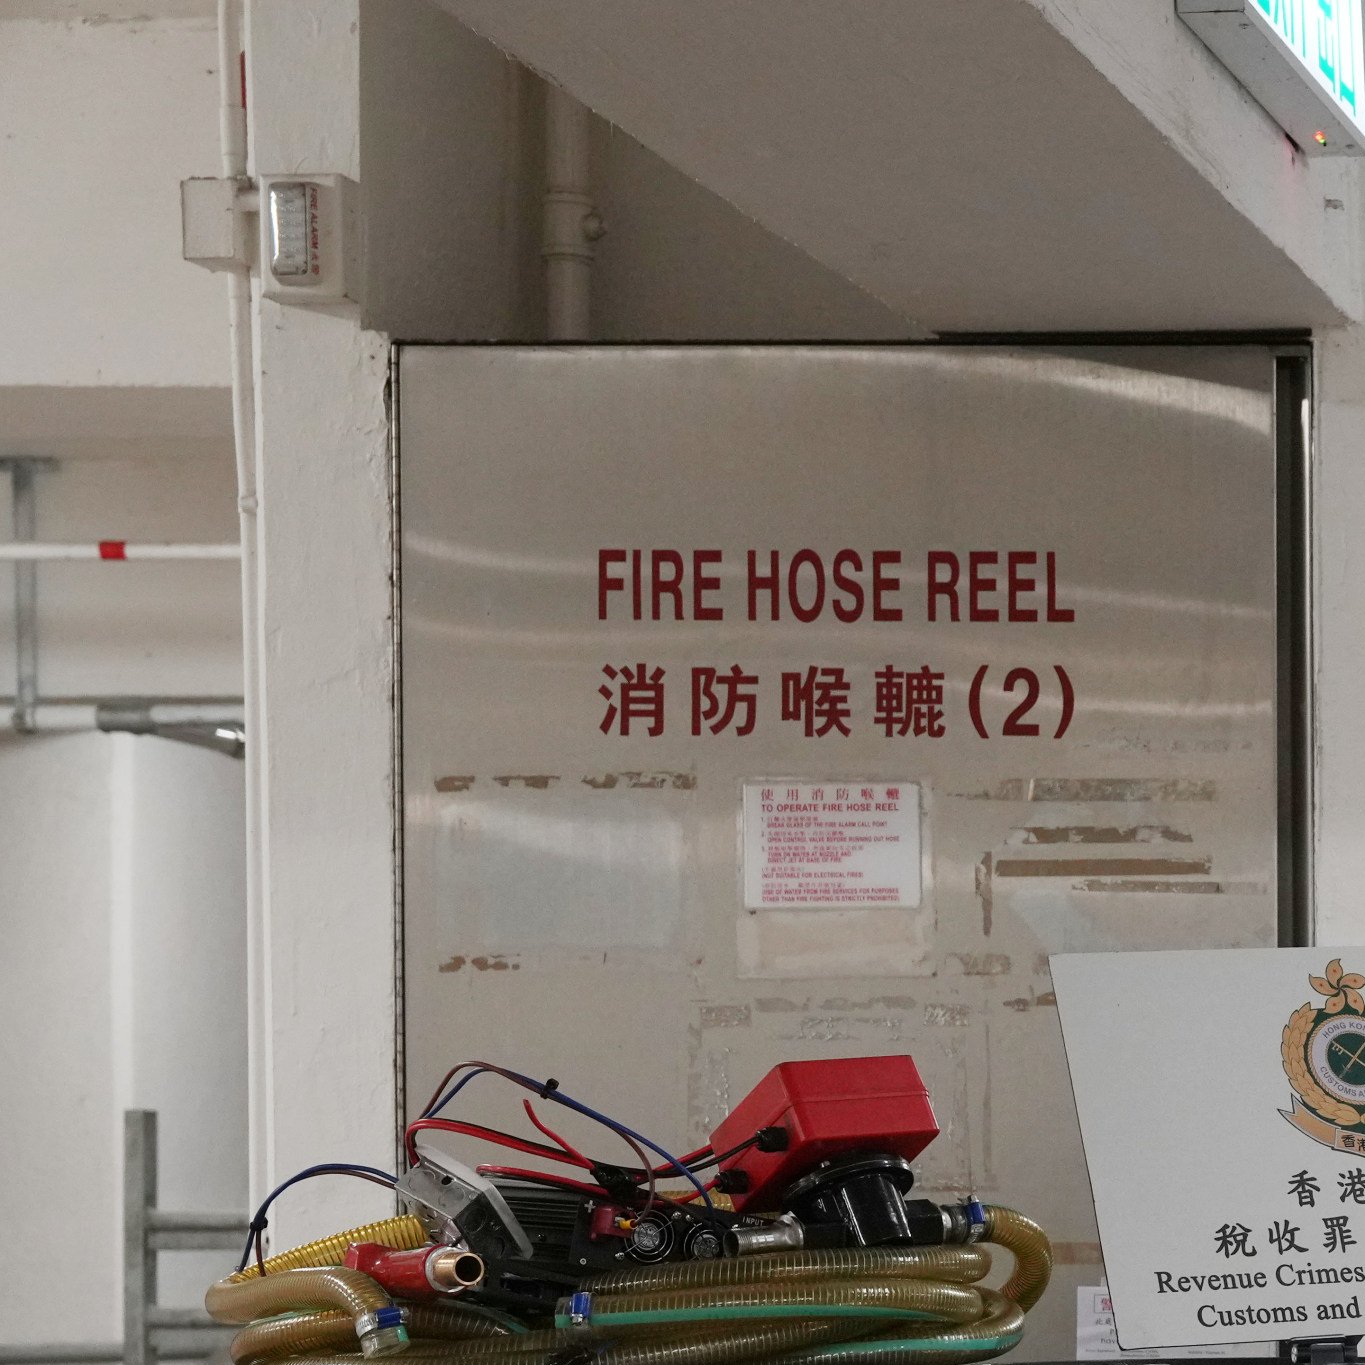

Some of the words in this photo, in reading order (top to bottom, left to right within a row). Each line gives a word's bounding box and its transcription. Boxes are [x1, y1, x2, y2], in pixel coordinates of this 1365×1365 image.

[597, 549, 725, 622] FIRE
[747, 548, 904, 622] HOSE
[926, 550, 1077, 623] REEL
[762, 804, 773, 813] TO
[777, 804, 819, 813] OPERATE
[822, 803, 843, 812] FIRE
[846, 803, 872, 812] HOSE
[875, 802, 899, 812] REEL
[1322, 1021, 1347, 1040] HONG
[1319, 1065, 1358, 1098] CUSTOMS
[742, 1216, 765, 1227] INPUT
[1154, 1270, 1268, 1294] Revenue
[1275, 1262, 1365, 1287] Crimes
[1196, 1303, 1308, 1328] Customs
[1316, 1295, 1362, 1321] and
